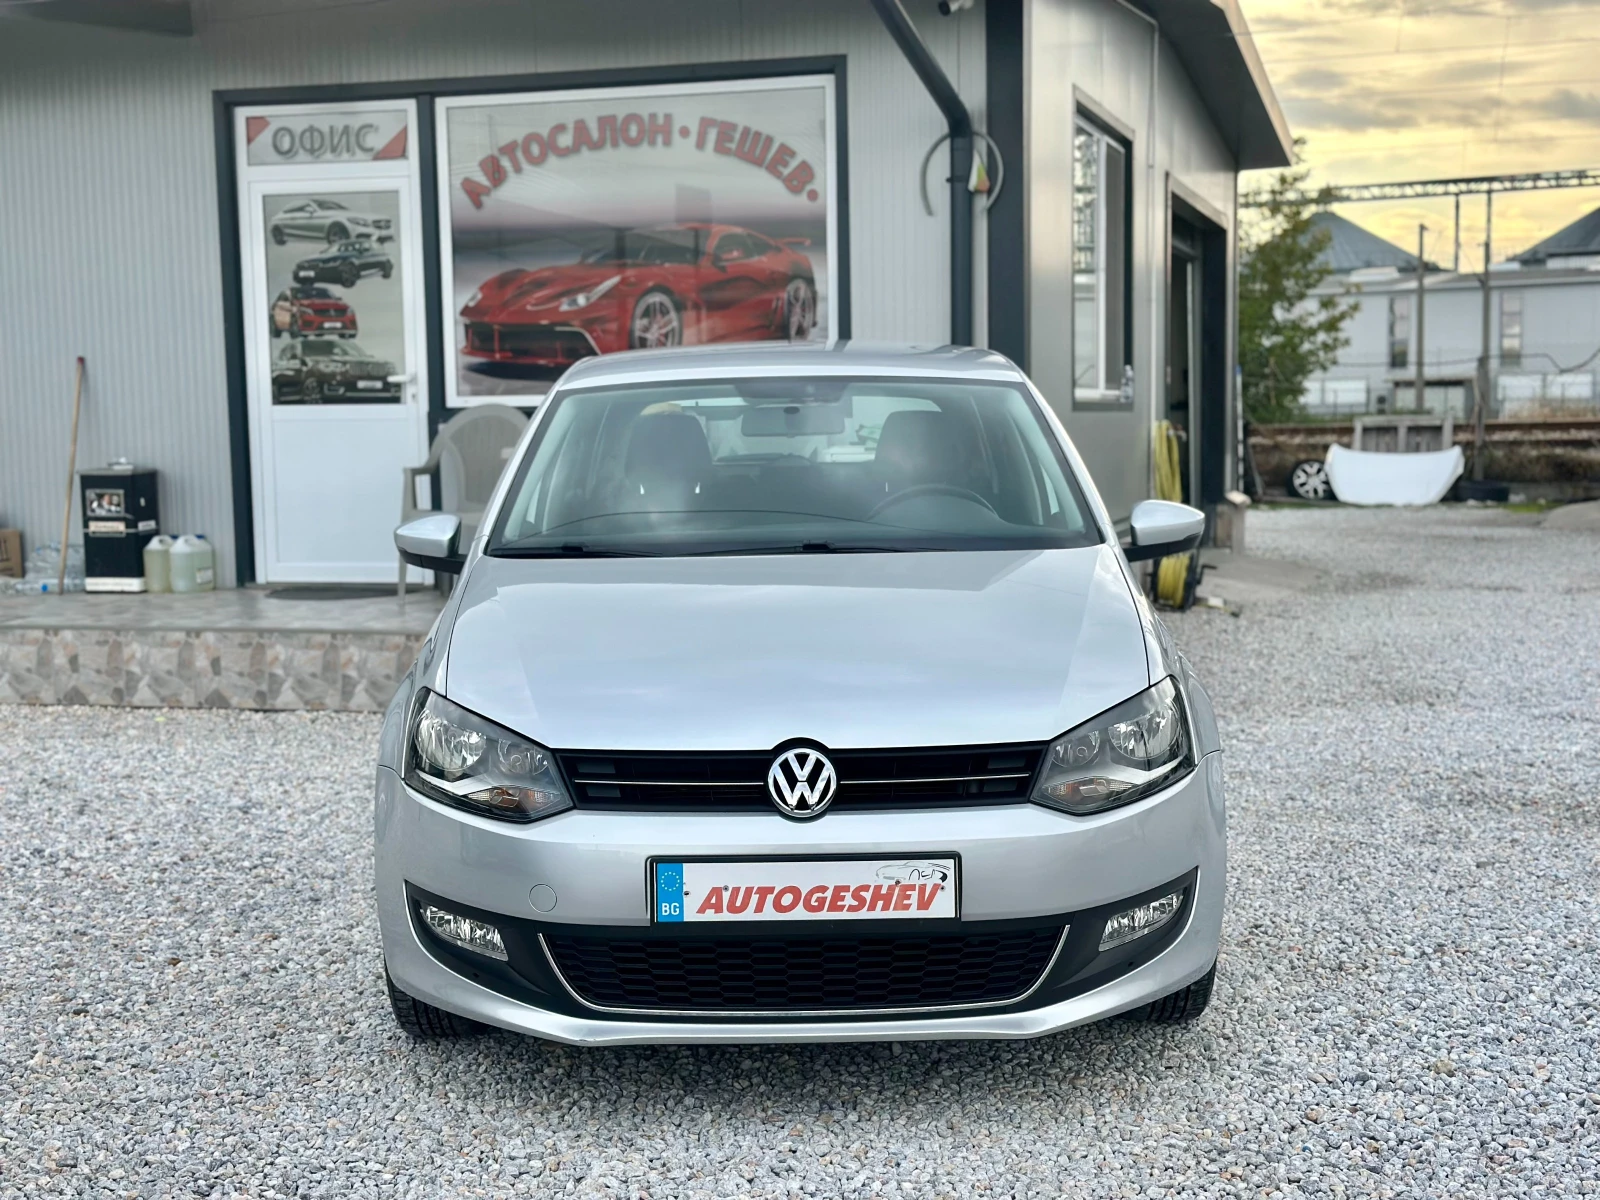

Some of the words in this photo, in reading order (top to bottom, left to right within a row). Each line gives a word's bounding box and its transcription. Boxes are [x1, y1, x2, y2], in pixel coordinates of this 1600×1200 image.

[271, 123, 376, 158] ОФИС
[460, 113, 673, 210] АВТОСАЛОН
[695, 116, 815, 194] ГЕШЕВ
[769, 749, 835, 814] VW
[661, 902, 680, 916] BG
[695, 882, 942, 914] AUTOGESHEV
